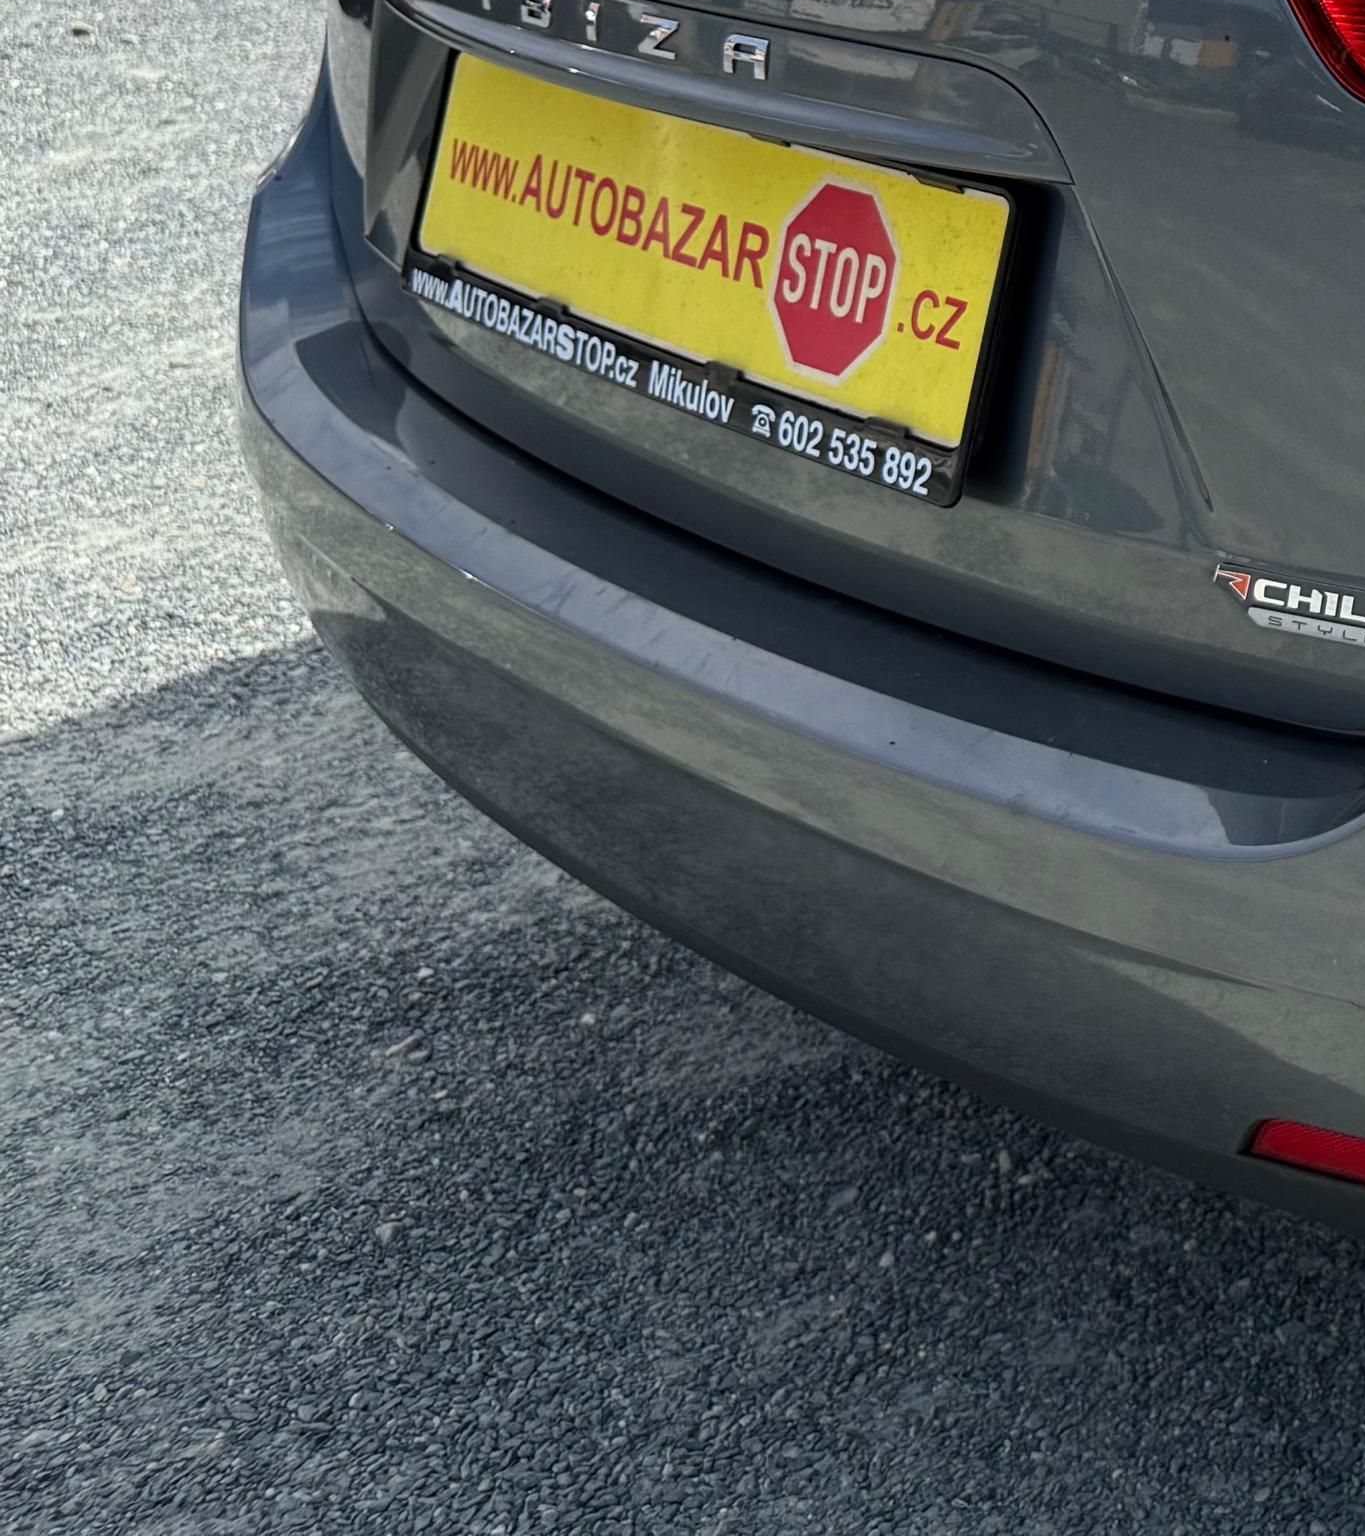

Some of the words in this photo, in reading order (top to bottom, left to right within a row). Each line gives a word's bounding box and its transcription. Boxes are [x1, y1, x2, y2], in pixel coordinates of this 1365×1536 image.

[782, 233, 887, 323] STOP
[411, 267, 640, 387] www.AUTOBAZARSTOP.cz
[648, 360, 735, 424] Mikulov
[778, 410, 824, 458] 602
[828, 427, 878, 476] 535
[882, 445, 933, 496] 892
